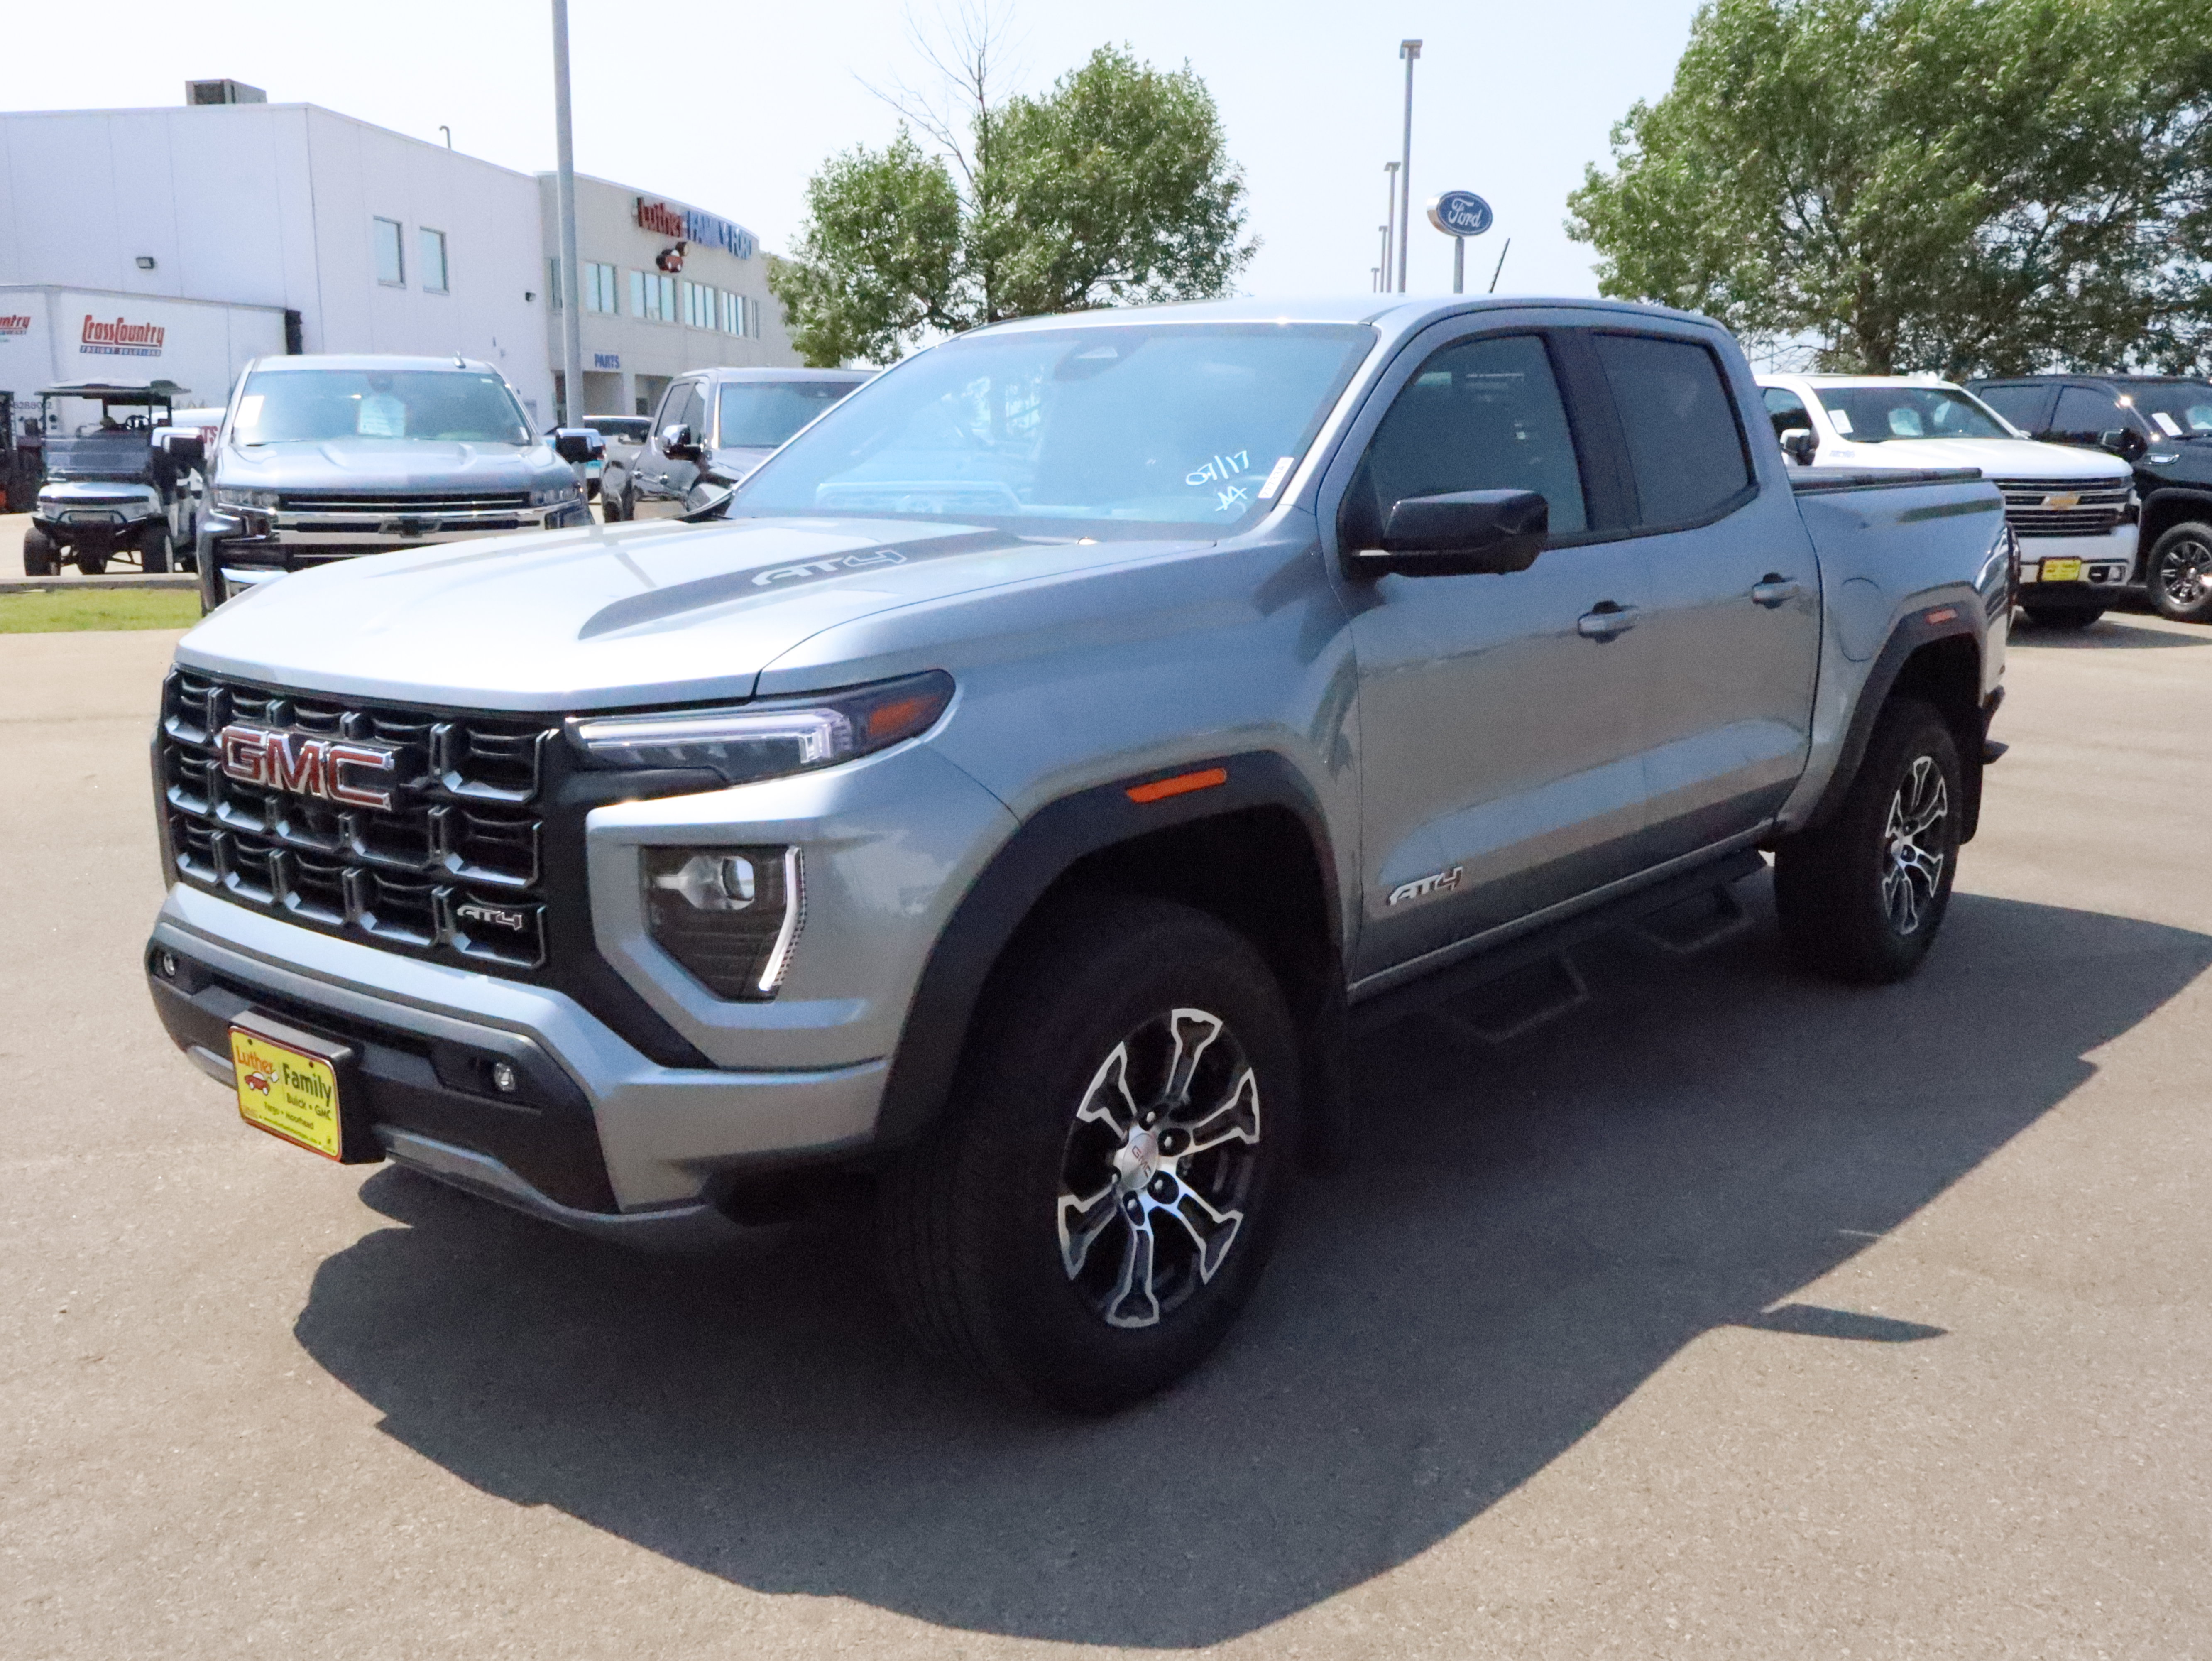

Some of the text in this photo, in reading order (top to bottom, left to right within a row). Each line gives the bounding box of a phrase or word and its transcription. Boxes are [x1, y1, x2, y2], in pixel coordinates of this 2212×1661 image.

[1448, 198, 1482, 227] Ford
[594, 353, 620, 369] PARTS
[751, 549, 907, 586] AT4
[221, 725, 394, 811] GMC
[1389, 866, 1463, 906] AT4
[457, 905, 522, 931] AT4
[236, 1045, 274, 1075] Luther
[282, 1062, 332, 1107] Family
[315, 1104, 331, 1121] GMC
[1131, 1145, 1152, 1178] GMC
